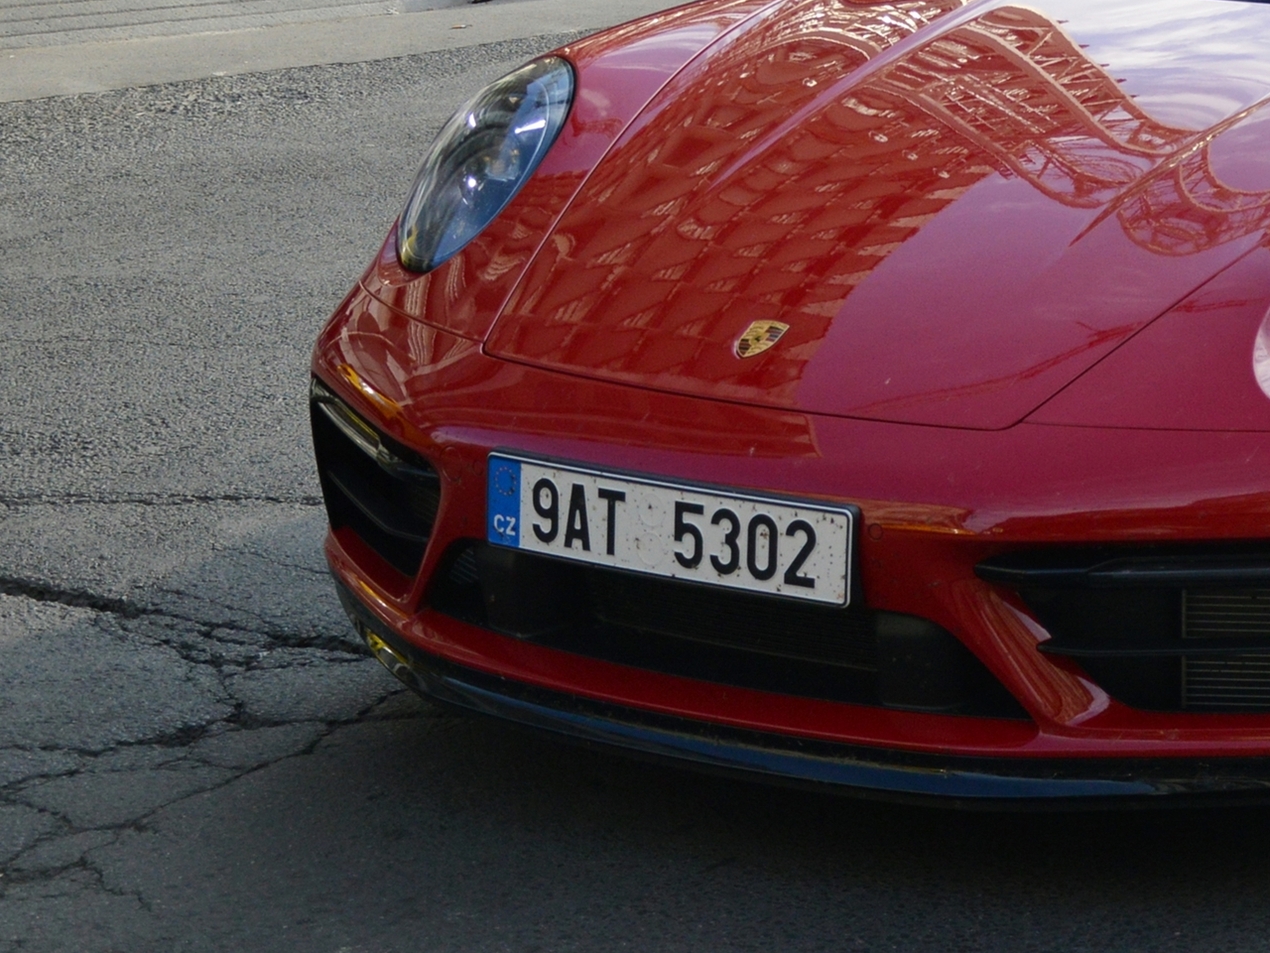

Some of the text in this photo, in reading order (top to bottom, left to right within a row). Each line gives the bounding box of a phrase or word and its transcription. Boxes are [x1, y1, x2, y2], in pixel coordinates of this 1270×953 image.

[493, 478, 818, 589] CZ 9AT 5302
